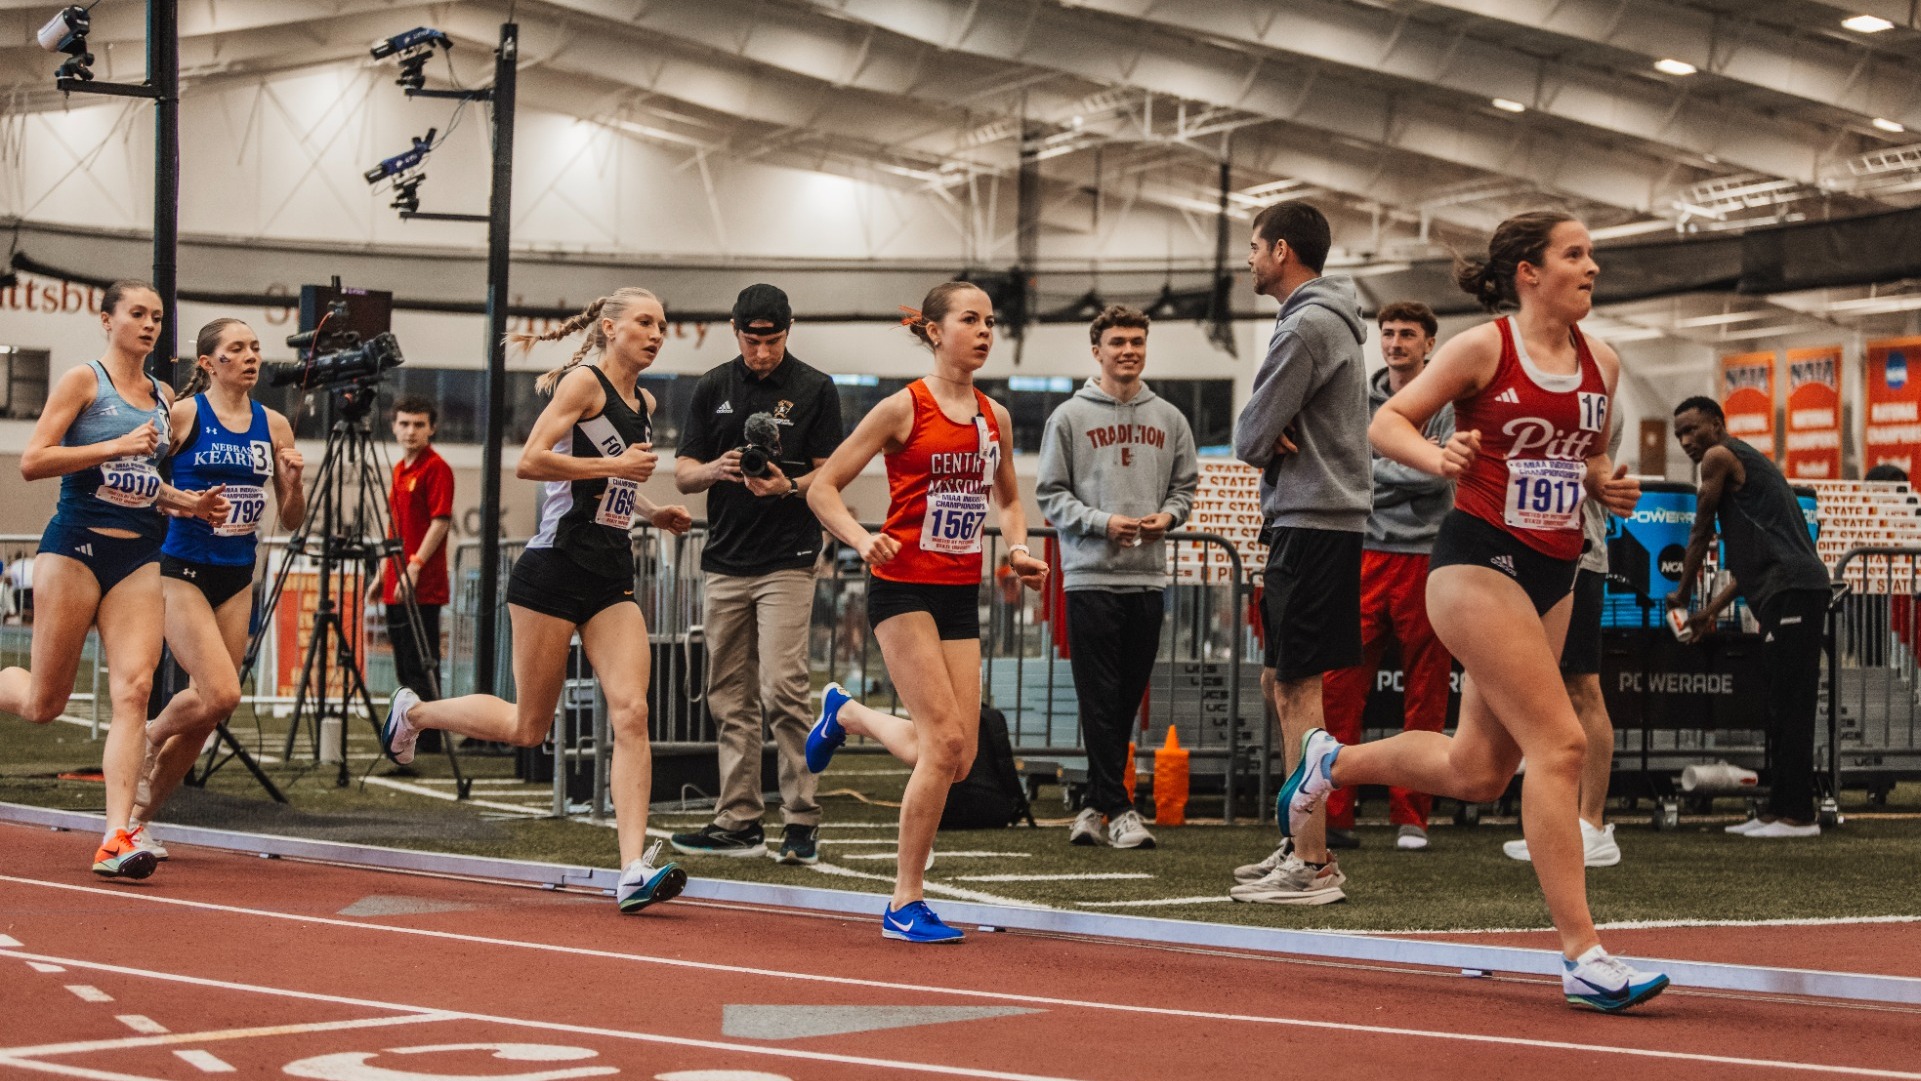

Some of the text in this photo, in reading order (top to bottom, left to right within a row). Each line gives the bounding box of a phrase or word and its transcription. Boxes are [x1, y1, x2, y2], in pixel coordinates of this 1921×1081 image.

[1582, 394, 1606, 430] 16
[1502, 416, 1593, 461] Pitt
[253, 444, 268, 471] 3
[108, 472, 160, 498] 2010
[1210, 475, 1257, 486] STATE
[1515, 477, 1580, 513] 1917
[932, 509, 986, 540] 1567
[1619, 672, 1733, 694] POWERADE
